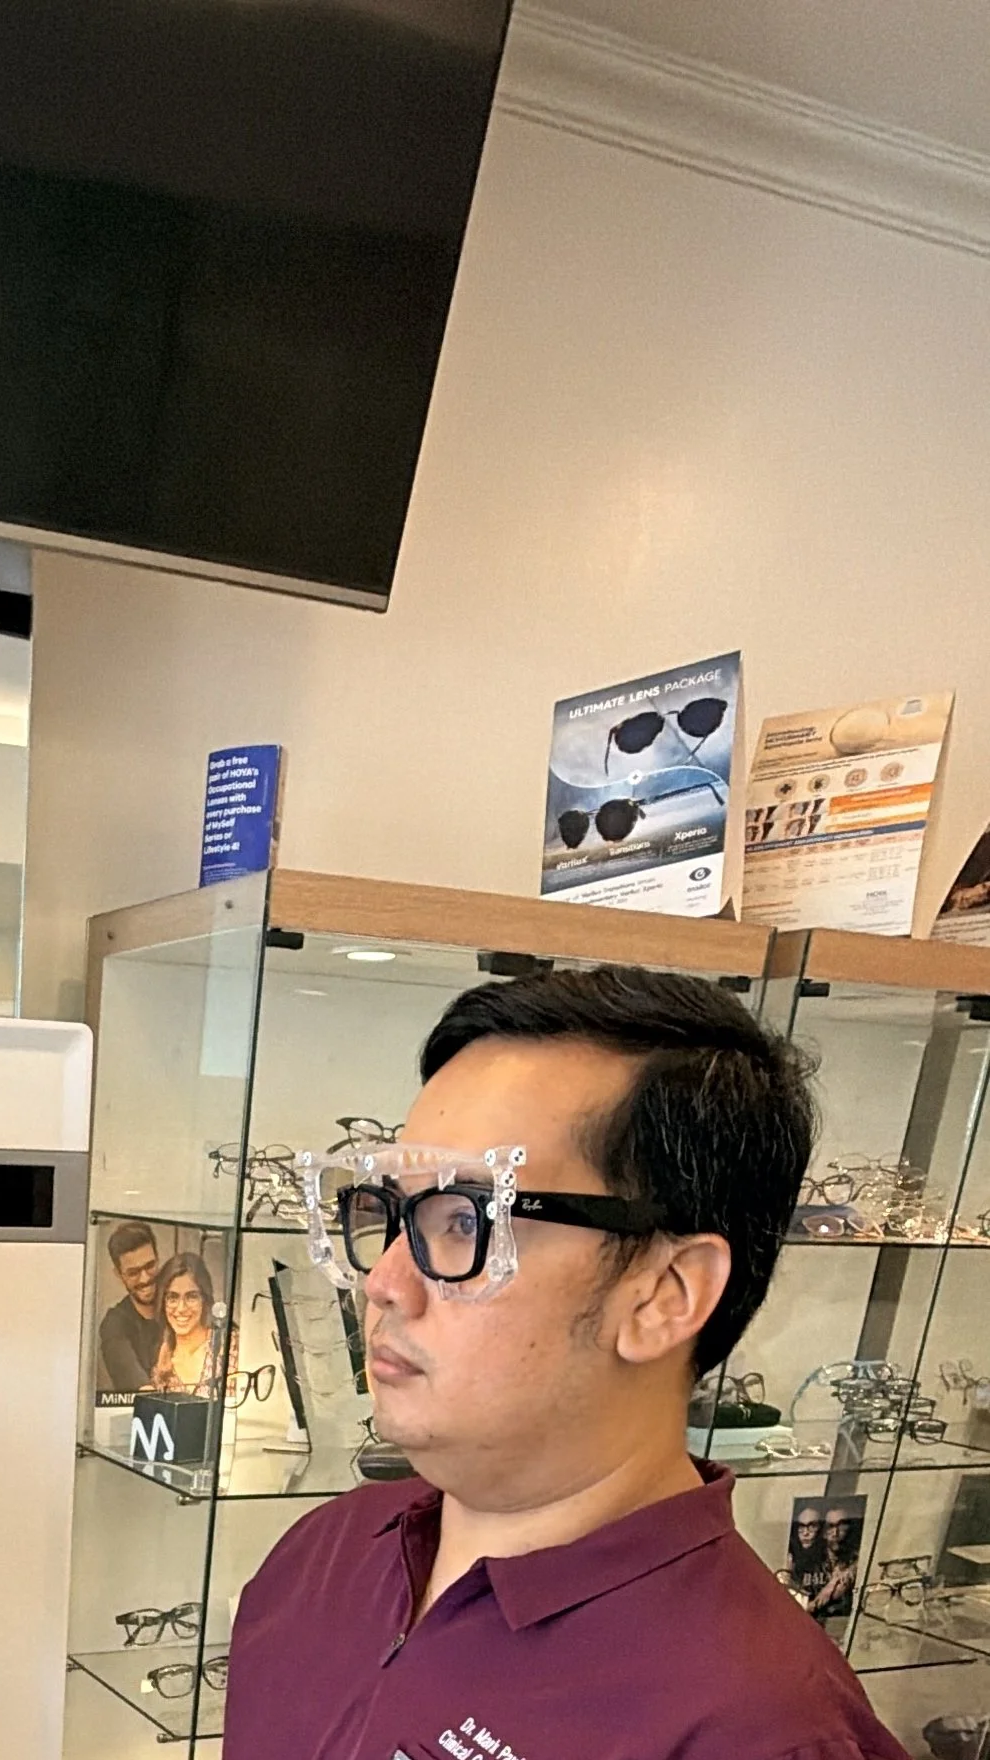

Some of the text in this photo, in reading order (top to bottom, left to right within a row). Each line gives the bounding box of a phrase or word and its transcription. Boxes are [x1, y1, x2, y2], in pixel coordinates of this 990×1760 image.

[569, 669, 723, 719] ULTIMATE LENS PACKAGE
[232, 756, 249, 765] free
[222, 769, 230, 779] of
[208, 779, 257, 794] Occupational
[229, 792, 247, 803] with
[206, 805, 262, 819] every purchase
[224, 832, 233, 840] or
[673, 826, 708, 841] Xperio
[459, 1717, 476, 1736] Dr.
[472, 1727, 501, 1754] Mark
